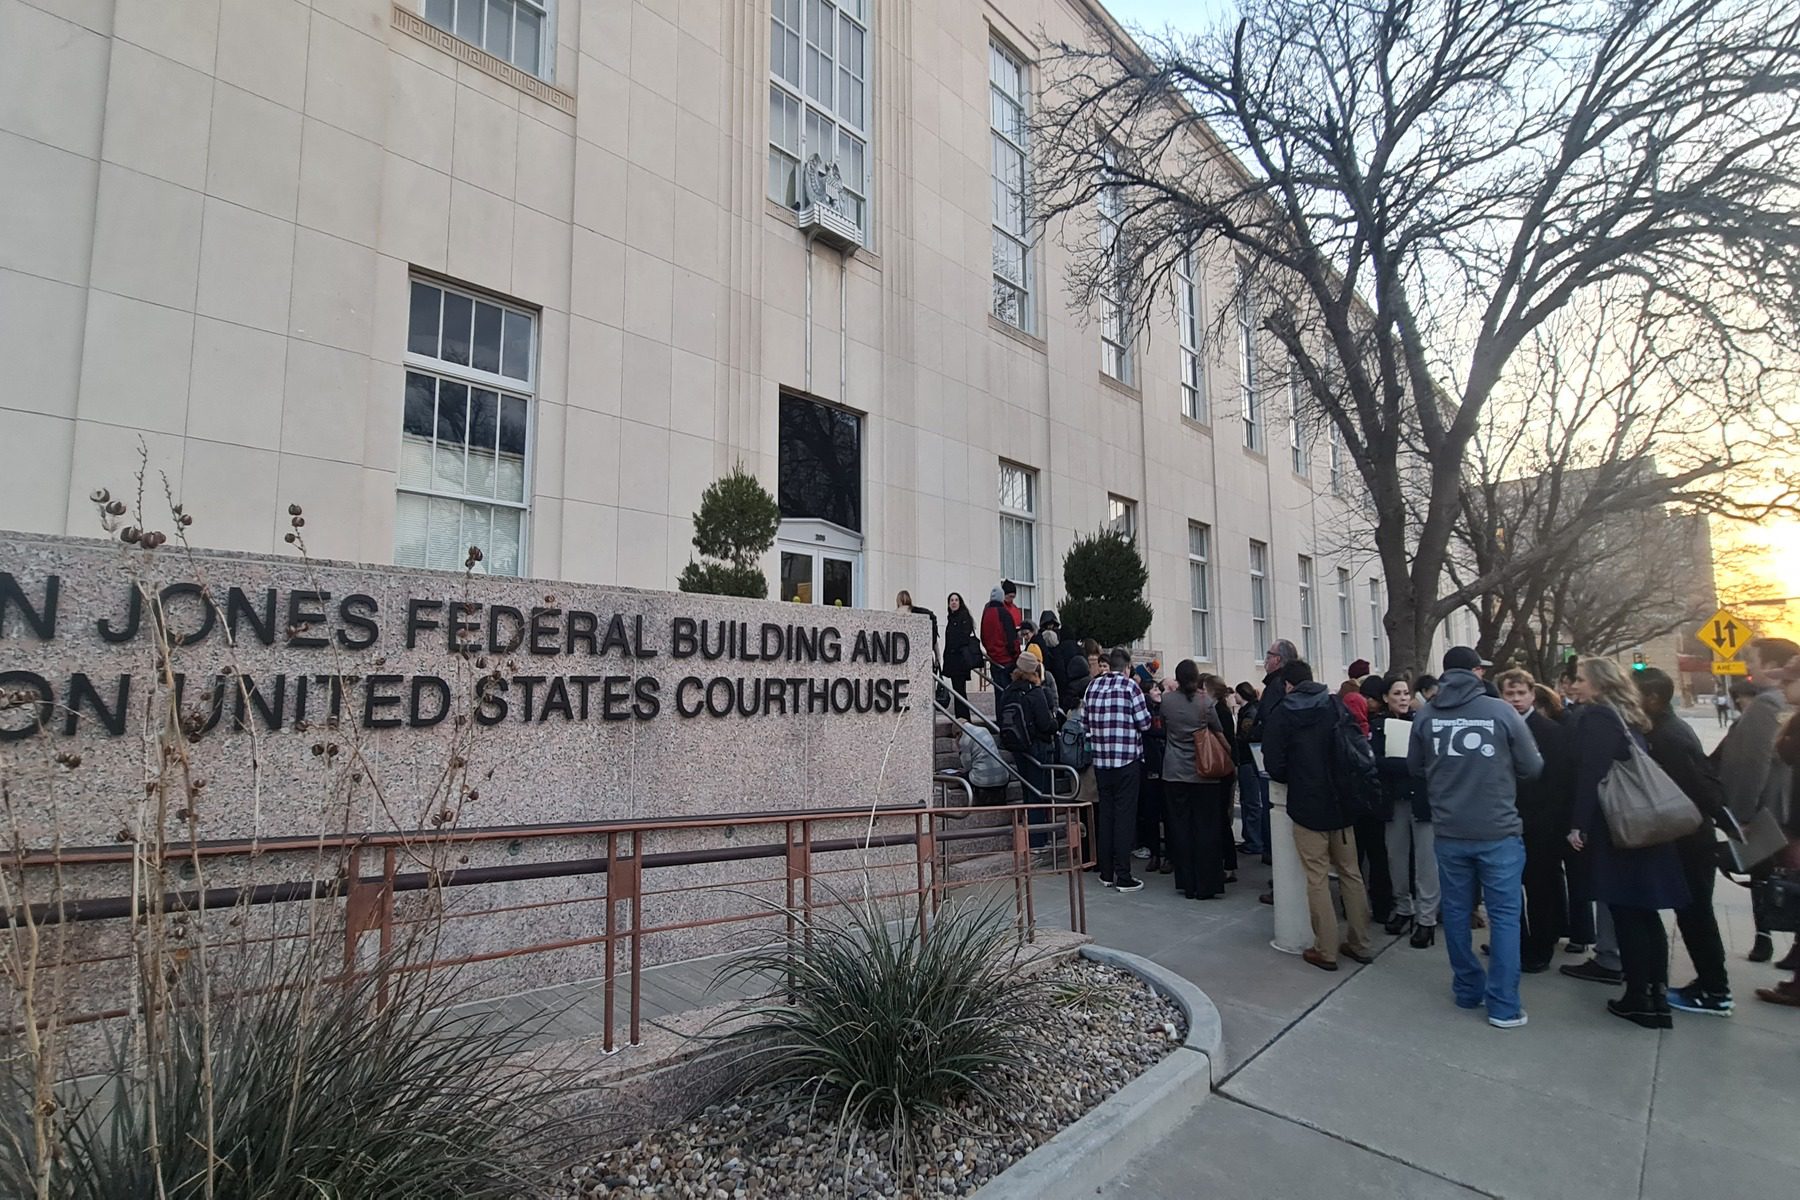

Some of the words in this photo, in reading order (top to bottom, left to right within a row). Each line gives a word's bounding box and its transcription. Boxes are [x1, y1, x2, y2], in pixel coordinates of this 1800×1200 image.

[97, 582, 380, 650] JONES
[406, 598, 658, 659] FEDERAL
[672, 616, 841, 664] BUILDING
[852, 630, 910, 666] AND
[171, 672, 452, 738] UNITED
[473, 674, 661, 726] STATES
[676, 675, 911, 719] COURTHOUSE
[1431, 718, 1494, 727] NewsChannel
